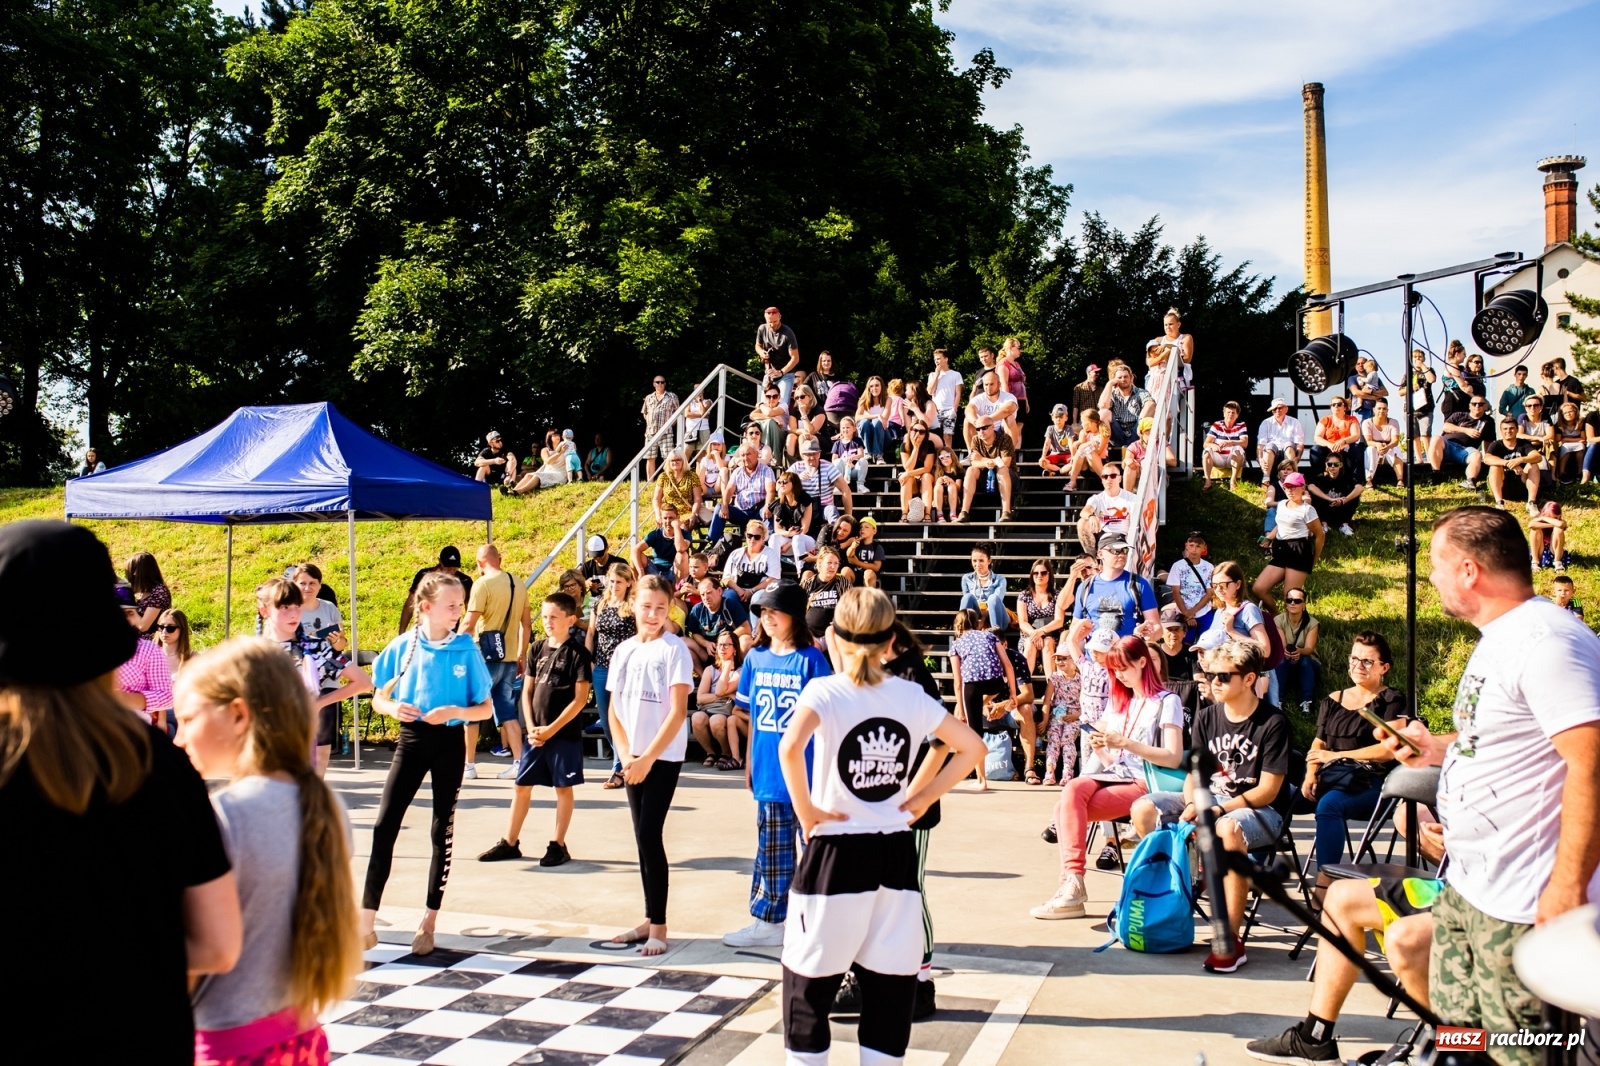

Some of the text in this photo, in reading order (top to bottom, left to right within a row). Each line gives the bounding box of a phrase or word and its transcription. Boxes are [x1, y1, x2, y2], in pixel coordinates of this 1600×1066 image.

[494, 632, 505, 659] adidas
[755, 671, 802, 690] BRONX
[756, 688, 800, 733] 22
[848, 759, 876, 773] HIP
[985, 759, 1008, 770] OVELY
[1129, 900, 1145, 934] PUMA
